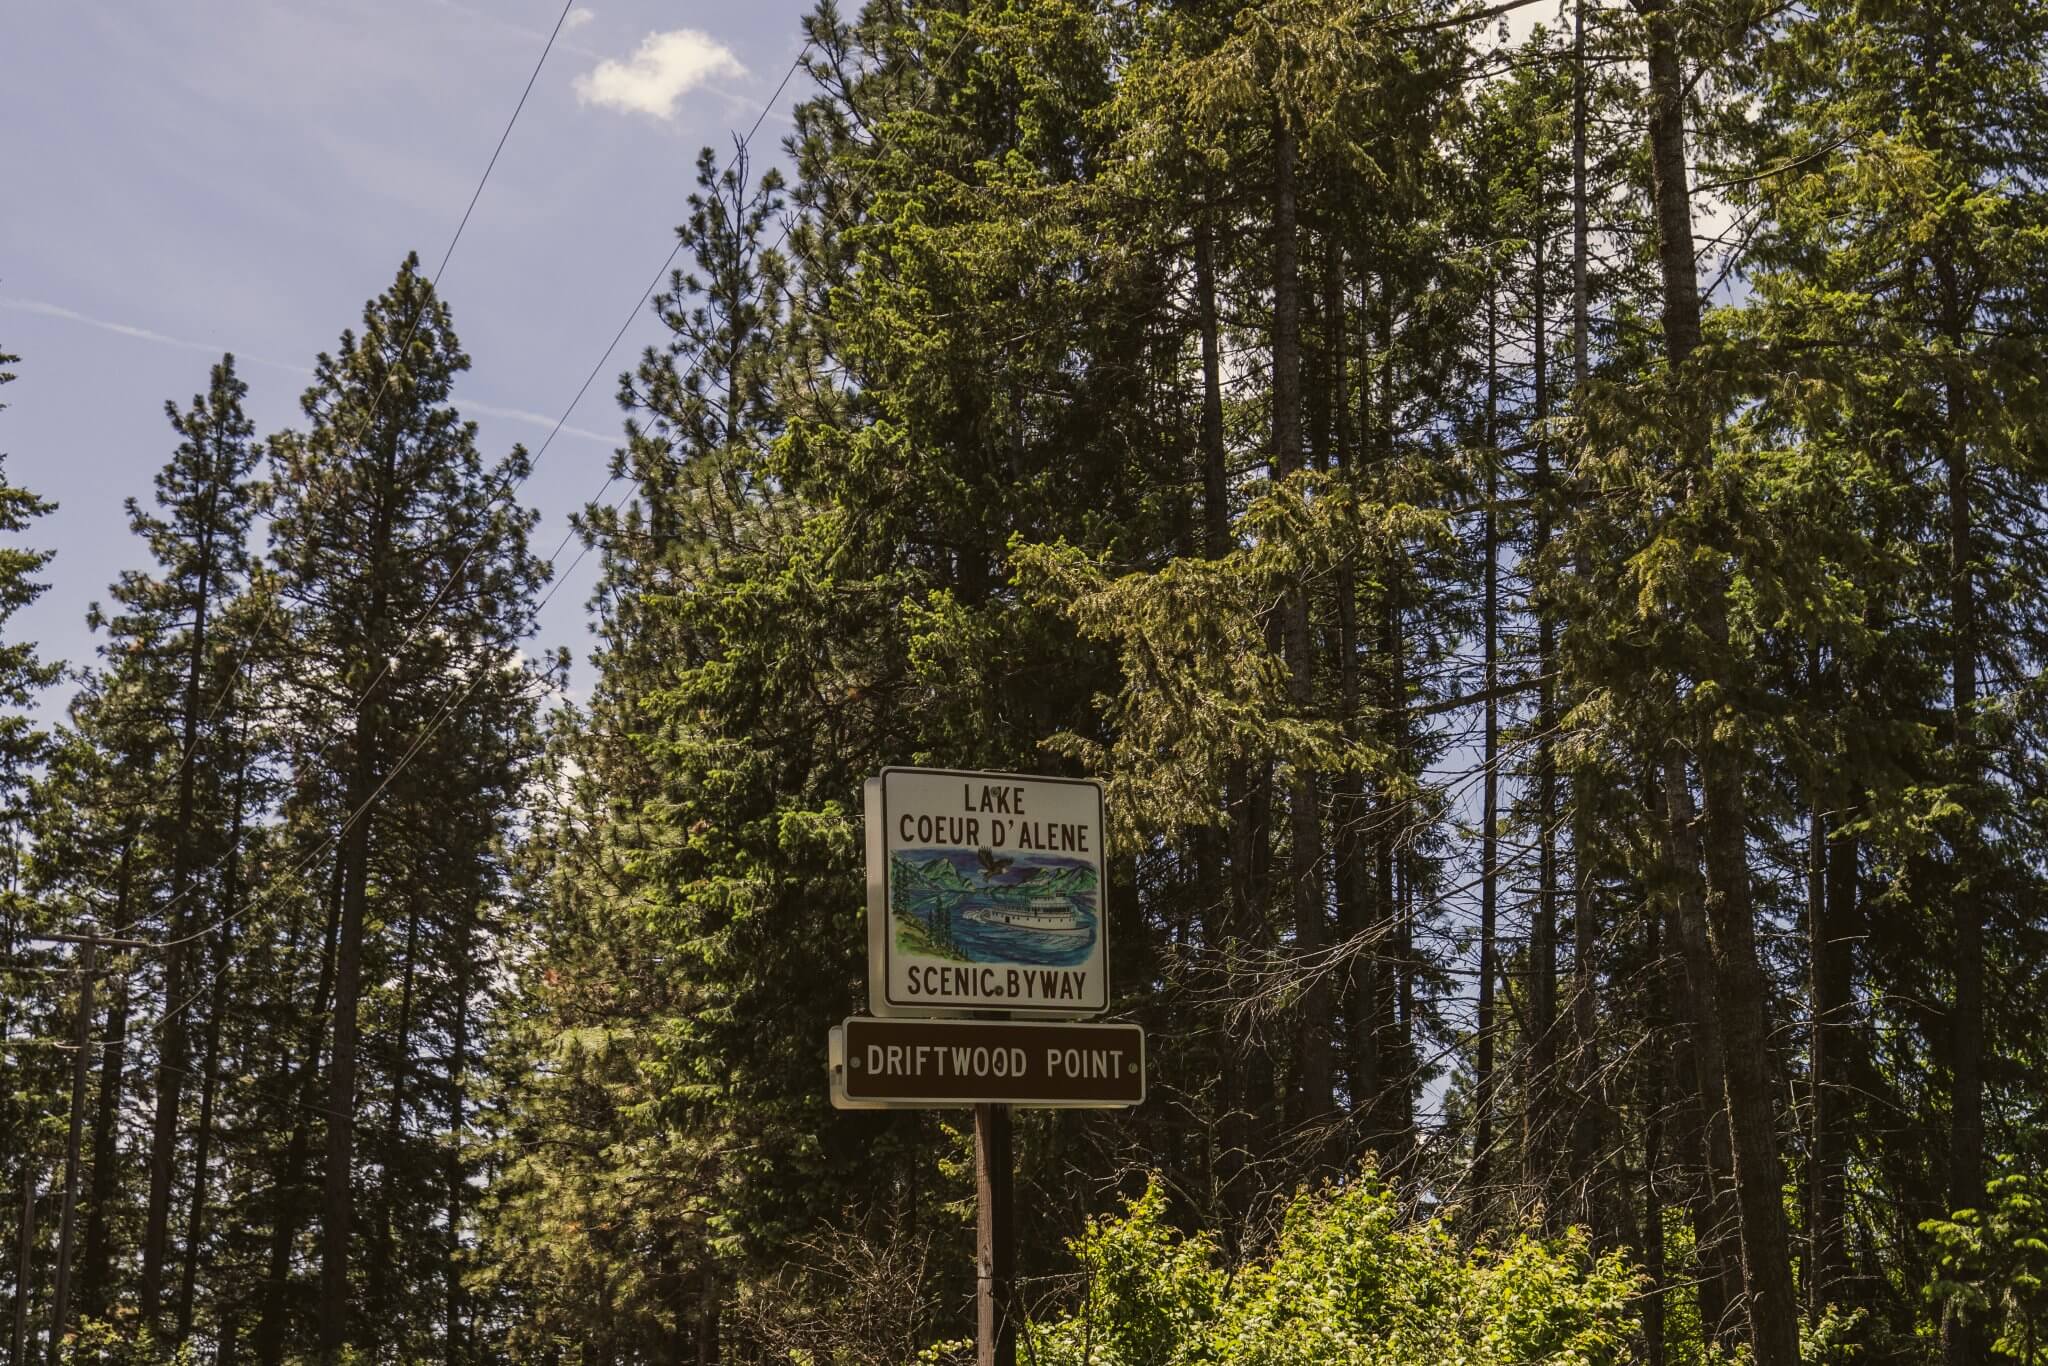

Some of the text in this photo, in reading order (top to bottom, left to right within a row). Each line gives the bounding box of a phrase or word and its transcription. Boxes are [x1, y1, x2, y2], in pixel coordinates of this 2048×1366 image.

[964, 784, 1025, 814] LAKE
[900, 814, 1089, 852] COEUR D'ALENE
[907, 965, 1086, 1000] SCENIC BYWAY
[867, 1045, 1123, 1079] DRIFTWOOD POINT
